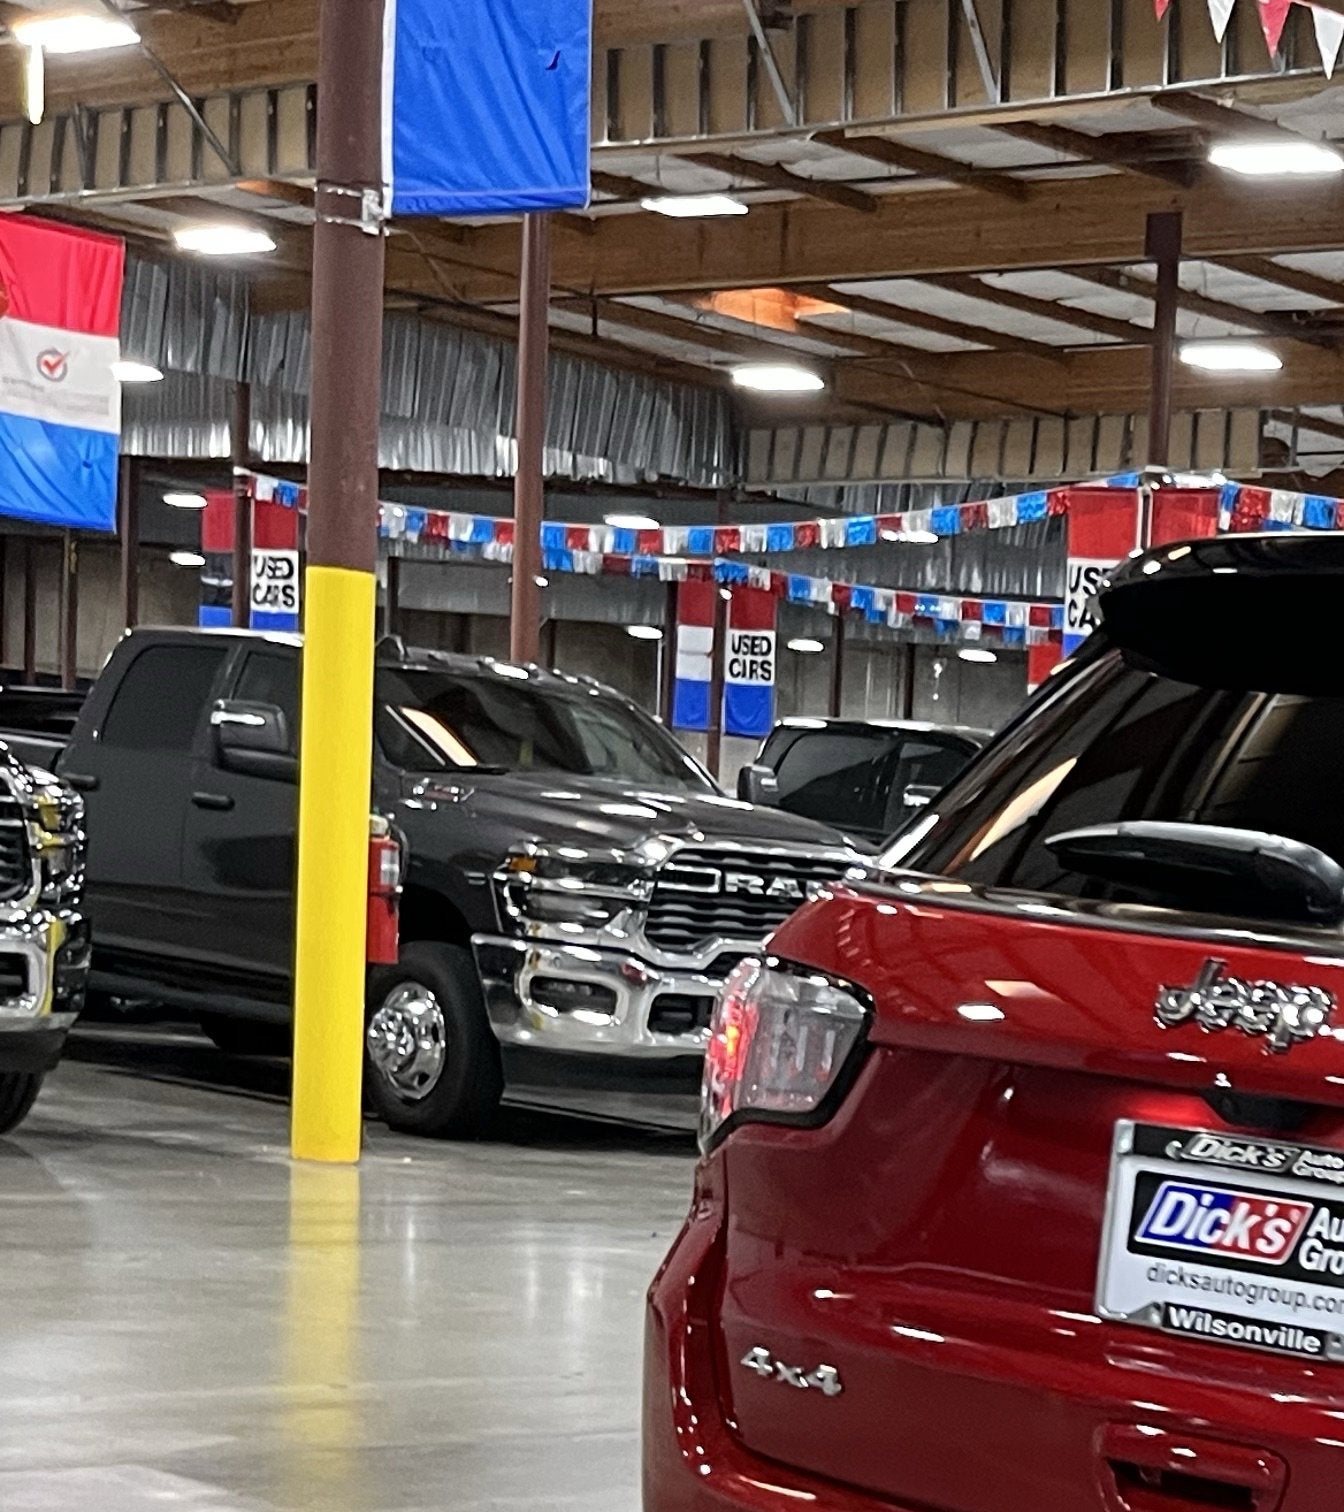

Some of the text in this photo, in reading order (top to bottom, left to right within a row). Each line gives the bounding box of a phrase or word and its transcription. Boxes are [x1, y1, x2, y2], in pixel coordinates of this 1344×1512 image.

[731, 634, 772, 657] USED
[1154, 956, 1333, 1054] Jeep
[1150, 1190, 1299, 1255] Dick's
[1167, 1305, 1322, 1354] Wilsonville
[740, 1346, 842, 1397] 4x4
